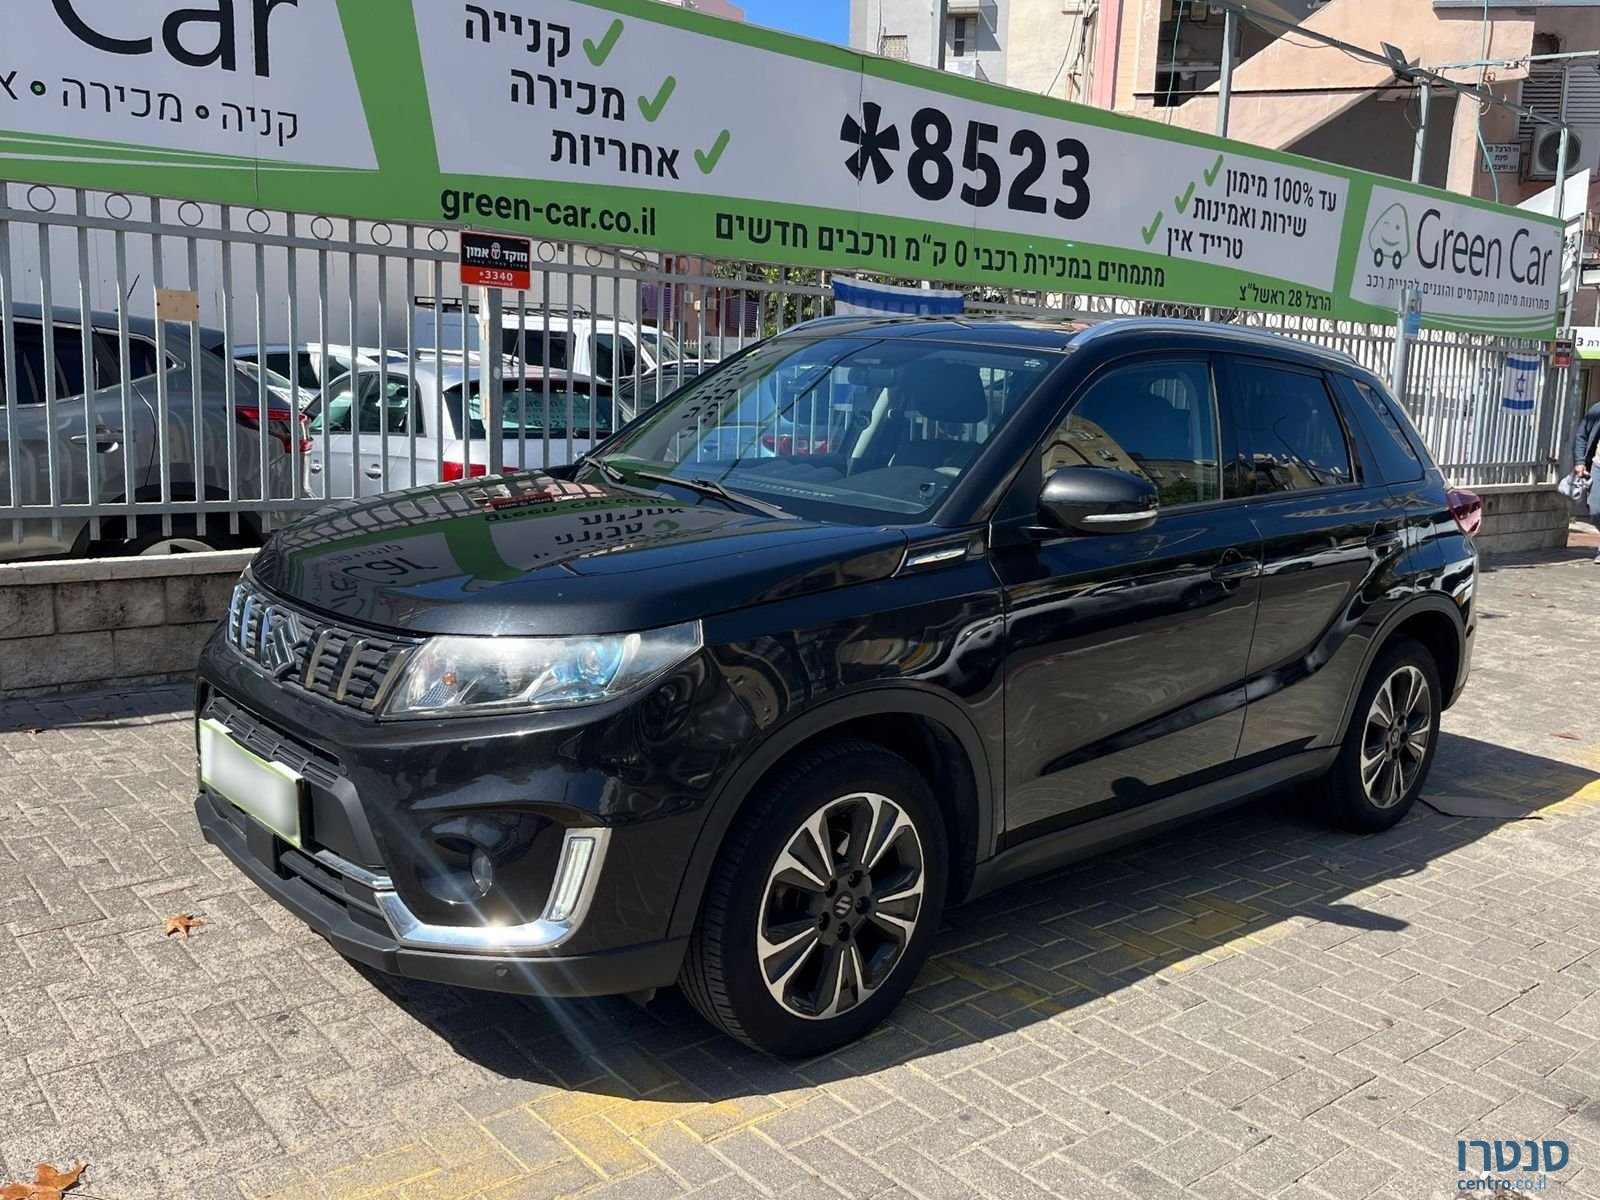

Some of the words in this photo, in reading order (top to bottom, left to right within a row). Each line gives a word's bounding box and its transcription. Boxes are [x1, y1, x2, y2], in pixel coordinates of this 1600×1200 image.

[465, 4, 571, 67] קנייה
[62, 78, 183, 122] מכירה
[511, 69, 625, 121] מכירה
[222, 102, 298, 147] קניה
[550, 129, 680, 180] אחריות
[1226, 169, 1267, 198] מימון
[1274, 177, 1313, 208] 100%
[440, 188, 656, 236] green-car.co.il
[1193, 197, 1256, 229] ואמינות
[1319, 189, 1337, 212] עד
[716, 213, 808, 250] חדשים
[1260, 210, 1307, 238] שירות
[466, 246, 489, 258] אמון
[818, 226, 896, 259] ורכבים
[954, 239, 968, 268] 0
[1167, 227, 1193, 256] אין
[1199, 232, 1243, 260] טרייד
[1417, 208, 1501, 280] Green
[1509, 228, 1552, 287] Car
[503, 250, 528, 263] מוקד
[974, 246, 1017, 272] רכבי
[1025, 252, 1092, 280] במכירת
[1097, 258, 1165, 288] מתמחים
[1366, 274, 1384, 289] רכב
[1288, 290, 1302, 308] 28
[1305, 293, 1331, 312] הרצל
[1457, 287, 1495, 304] מתקדמים
[1498, 293, 1518, 307] מימון
[1520, 296, 1549, 310] פתרונות
